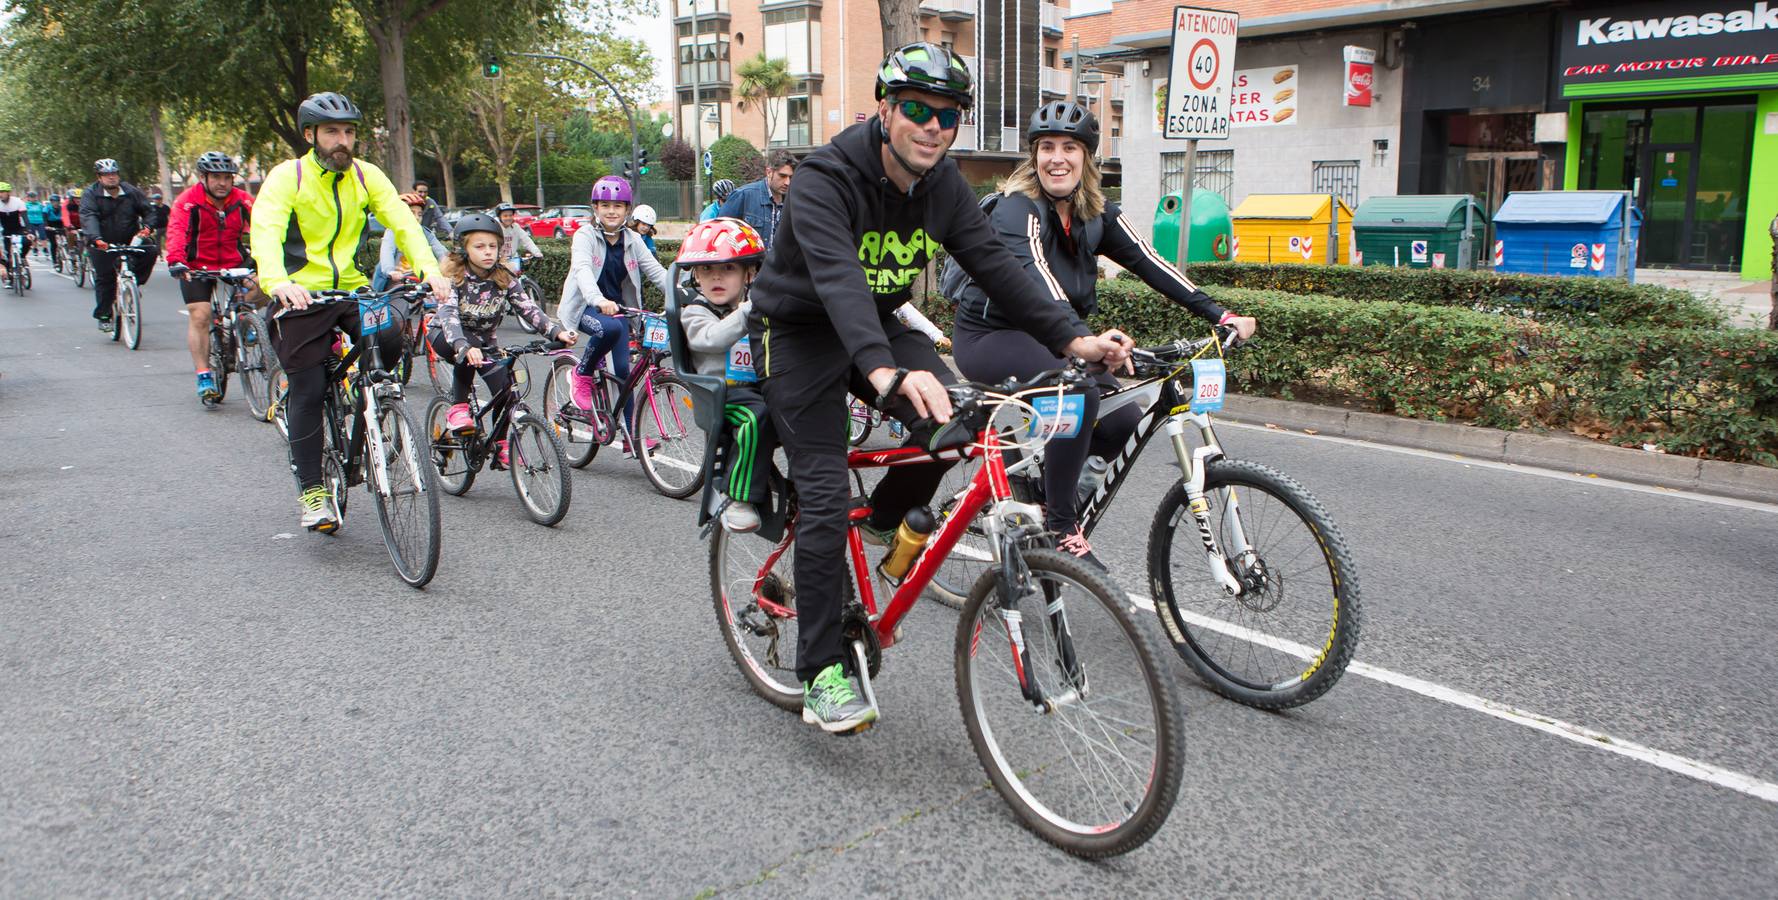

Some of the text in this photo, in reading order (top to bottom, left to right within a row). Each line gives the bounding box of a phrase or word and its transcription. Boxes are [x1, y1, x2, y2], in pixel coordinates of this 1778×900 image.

[1195, 56, 1213, 74] 40
[1563, 64, 1610, 77] CAR
[1614, 57, 1707, 73] MOTOR
[1472, 75, 1490, 91] 34
[1182, 95, 1217, 112] ZONA
[1169, 115, 1227, 134] ESCOLAR
[650, 331, 665, 342] 136
[1200, 383, 1219, 398] 208
